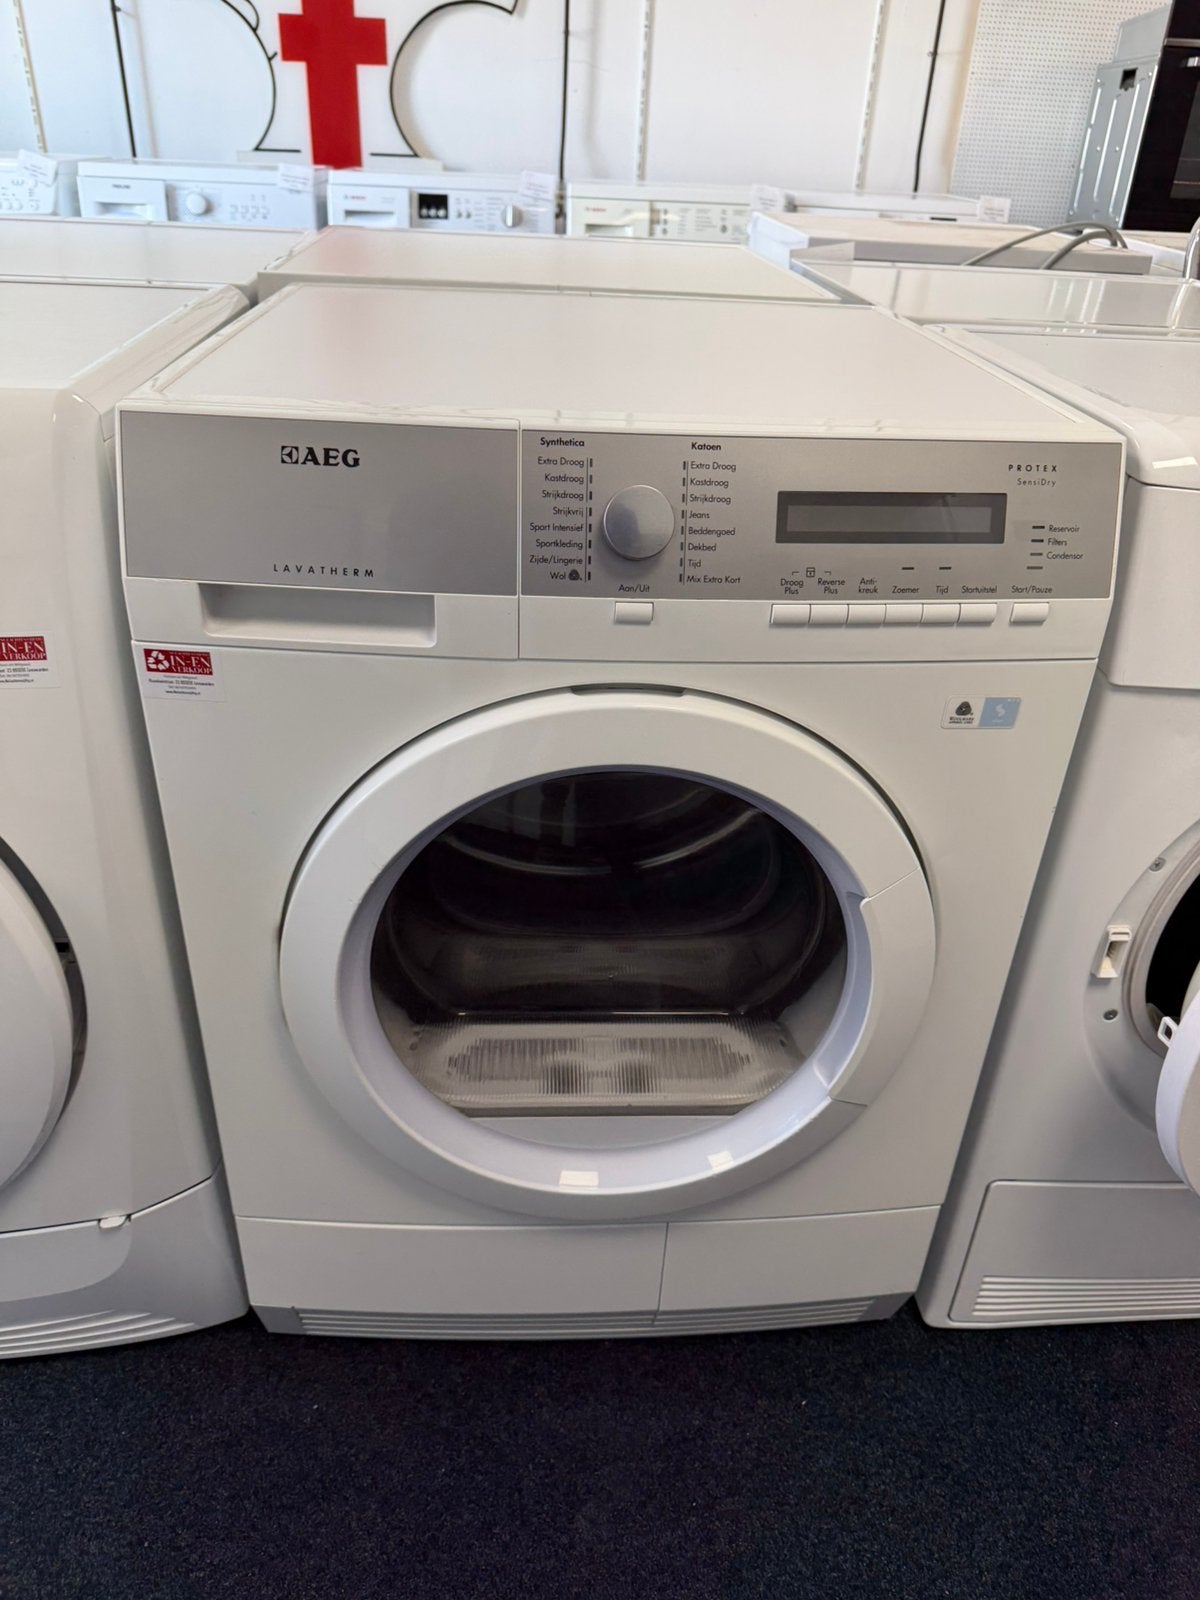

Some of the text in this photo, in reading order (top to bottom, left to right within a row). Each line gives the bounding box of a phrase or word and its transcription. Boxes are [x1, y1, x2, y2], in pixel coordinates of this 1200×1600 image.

[540, 437, 585, 449] Synthetica
[691, 442, 721, 451] Katoen
[300, 448, 360, 467] AEG
[538, 457, 584, 468] Extra Droog
[691, 462, 736, 472] Extra Droog
[1008, 464, 1058, 473] PROTEX
[545, 474, 584, 484] Kastdroog
[690, 478, 728, 488] Kastdroog
[1017, 478, 1057, 487] SensiDry
[542, 490, 584, 501] Strijkdroog
[690, 494, 731, 504] Strijkdroog
[553, 507, 583, 517] Strijkvrij
[688, 511, 710, 520] Jeans
[530, 523, 583, 533] Sport Intensief
[688, 527, 735, 536] Beddengoed
[1049, 524, 1080, 534] Reservoir
[536, 539, 583, 550] Sportkleding
[1047, 538, 1067, 547] Filters
[688, 543, 716, 552] Dekbed
[1046, 551, 1083, 560] Condensor
[530, 556, 583, 566] Zijde/Lingerie
[688, 559, 701, 568] Tijd
[273, 563, 374, 578] LAVATHERM
[550, 571, 566, 580] Wol
[687, 575, 740, 584] Mix Extra Kort
[781, 578, 804, 588] Droog
[818, 578, 845, 587] Reverse
[860, 577, 877, 586] Anti-
[618, 584, 650, 593] Aan/Uit
[784, 586, 799, 595] Plus
[824, 586, 838, 595] Plus
[858, 585, 878, 594] kreuk
[892, 585, 919, 594] Zoemer
[935, 585, 948, 594] Tijd
[962, 585, 997, 594] Startuitstel
[1011, 585, 1053, 594] Start/Pauze
[2, 642, 44, 653] IN-EN
[170, 655, 210, 667] IN-EN
